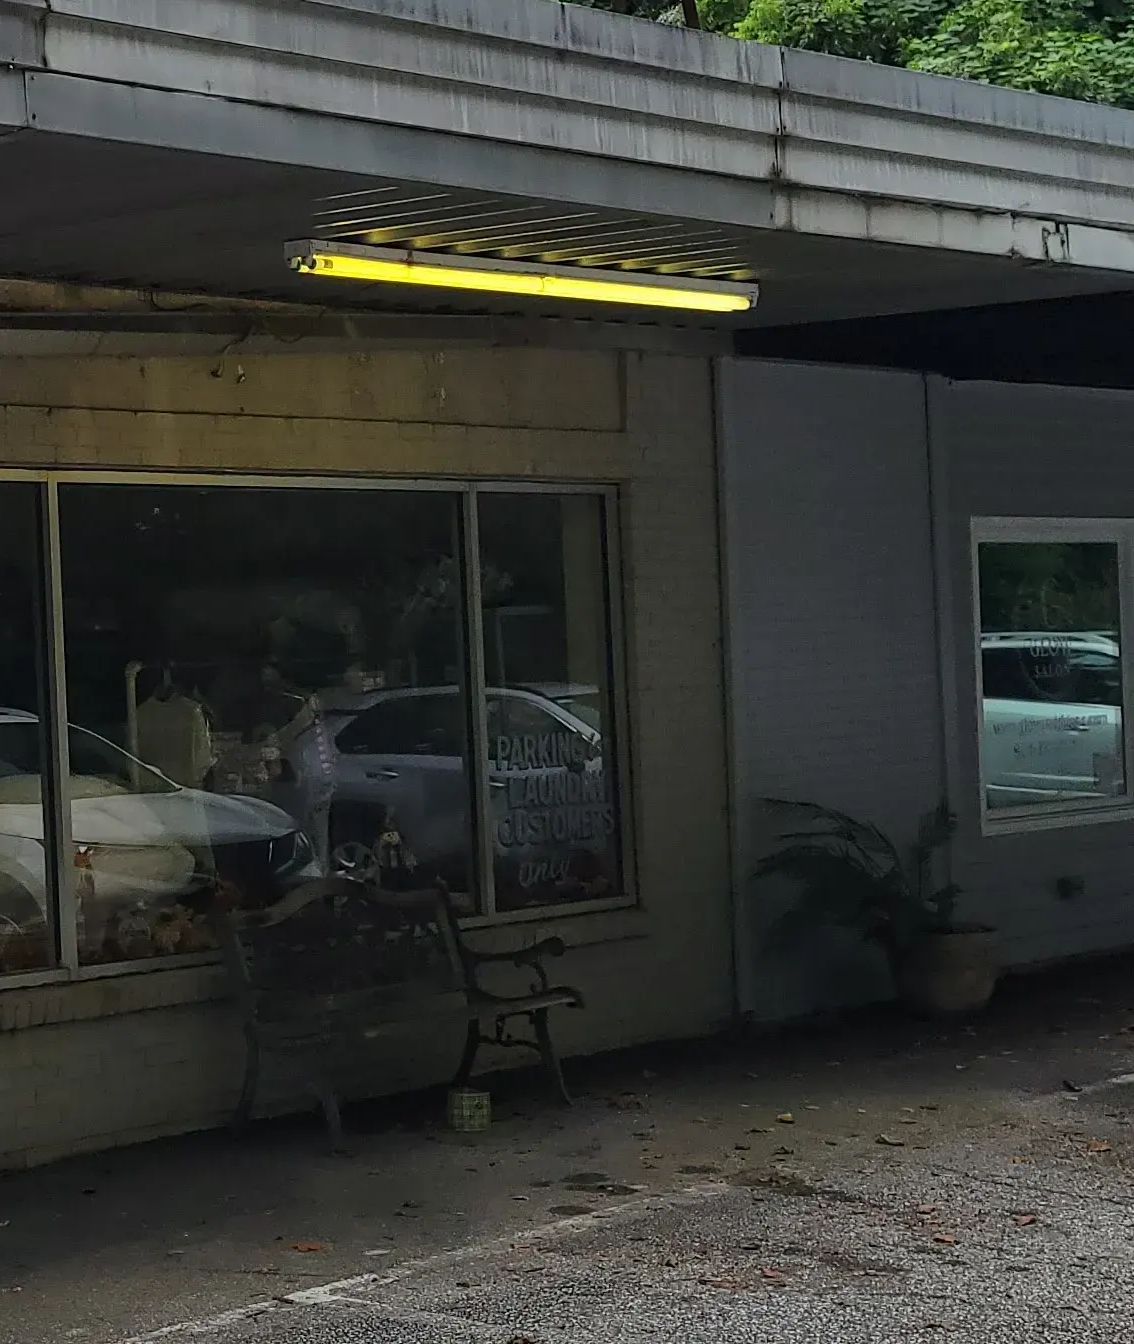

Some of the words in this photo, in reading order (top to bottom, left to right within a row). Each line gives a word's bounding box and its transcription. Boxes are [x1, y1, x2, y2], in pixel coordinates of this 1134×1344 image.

[496, 731, 585, 771] PARKING
[507, 769, 607, 809] LAUNDRY
[497, 807, 615, 847] CUSTOMERS
